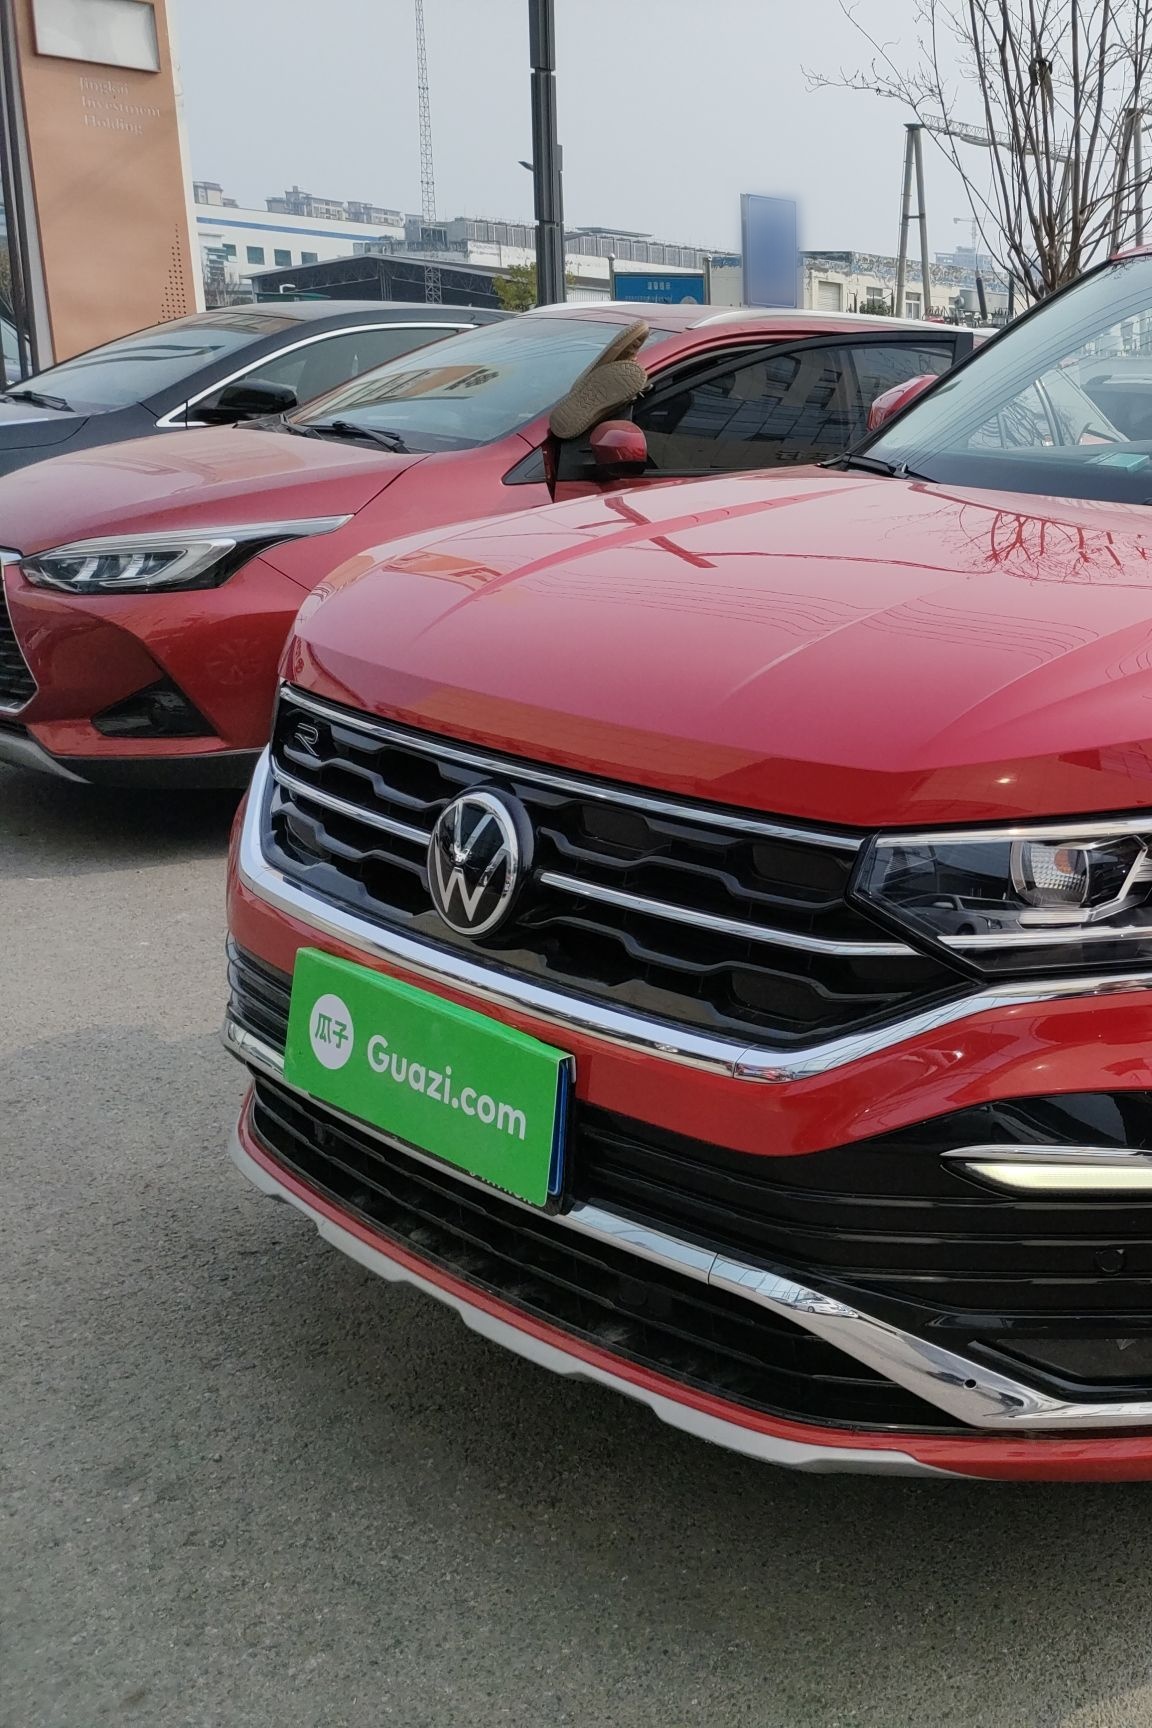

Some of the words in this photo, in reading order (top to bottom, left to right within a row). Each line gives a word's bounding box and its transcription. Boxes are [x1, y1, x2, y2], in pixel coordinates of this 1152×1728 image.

[82, 95, 160, 117] Investment
[84, 114, 144, 135] Holding
[294, 722, 320, 757] R
[314, 1012, 349, 1050] 瓜子
[367, 1034, 527, 1141] Guazi.com
